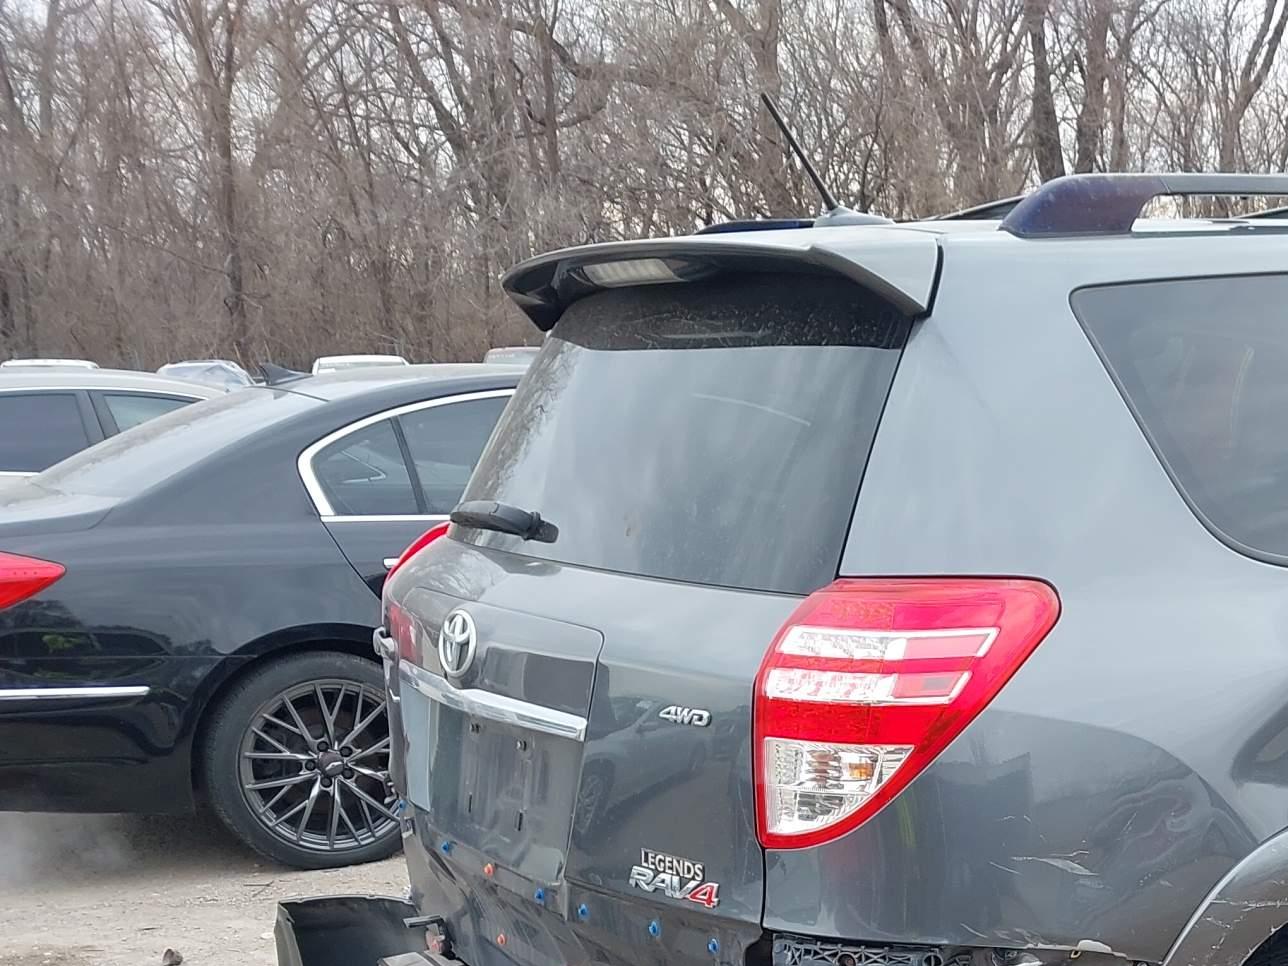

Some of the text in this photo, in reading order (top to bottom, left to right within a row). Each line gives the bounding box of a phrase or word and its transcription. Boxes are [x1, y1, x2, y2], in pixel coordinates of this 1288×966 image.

[659, 705, 710, 727] 4WD
[641, 848, 704, 881] LEGENDS
[629, 865, 720, 908] RAV4
